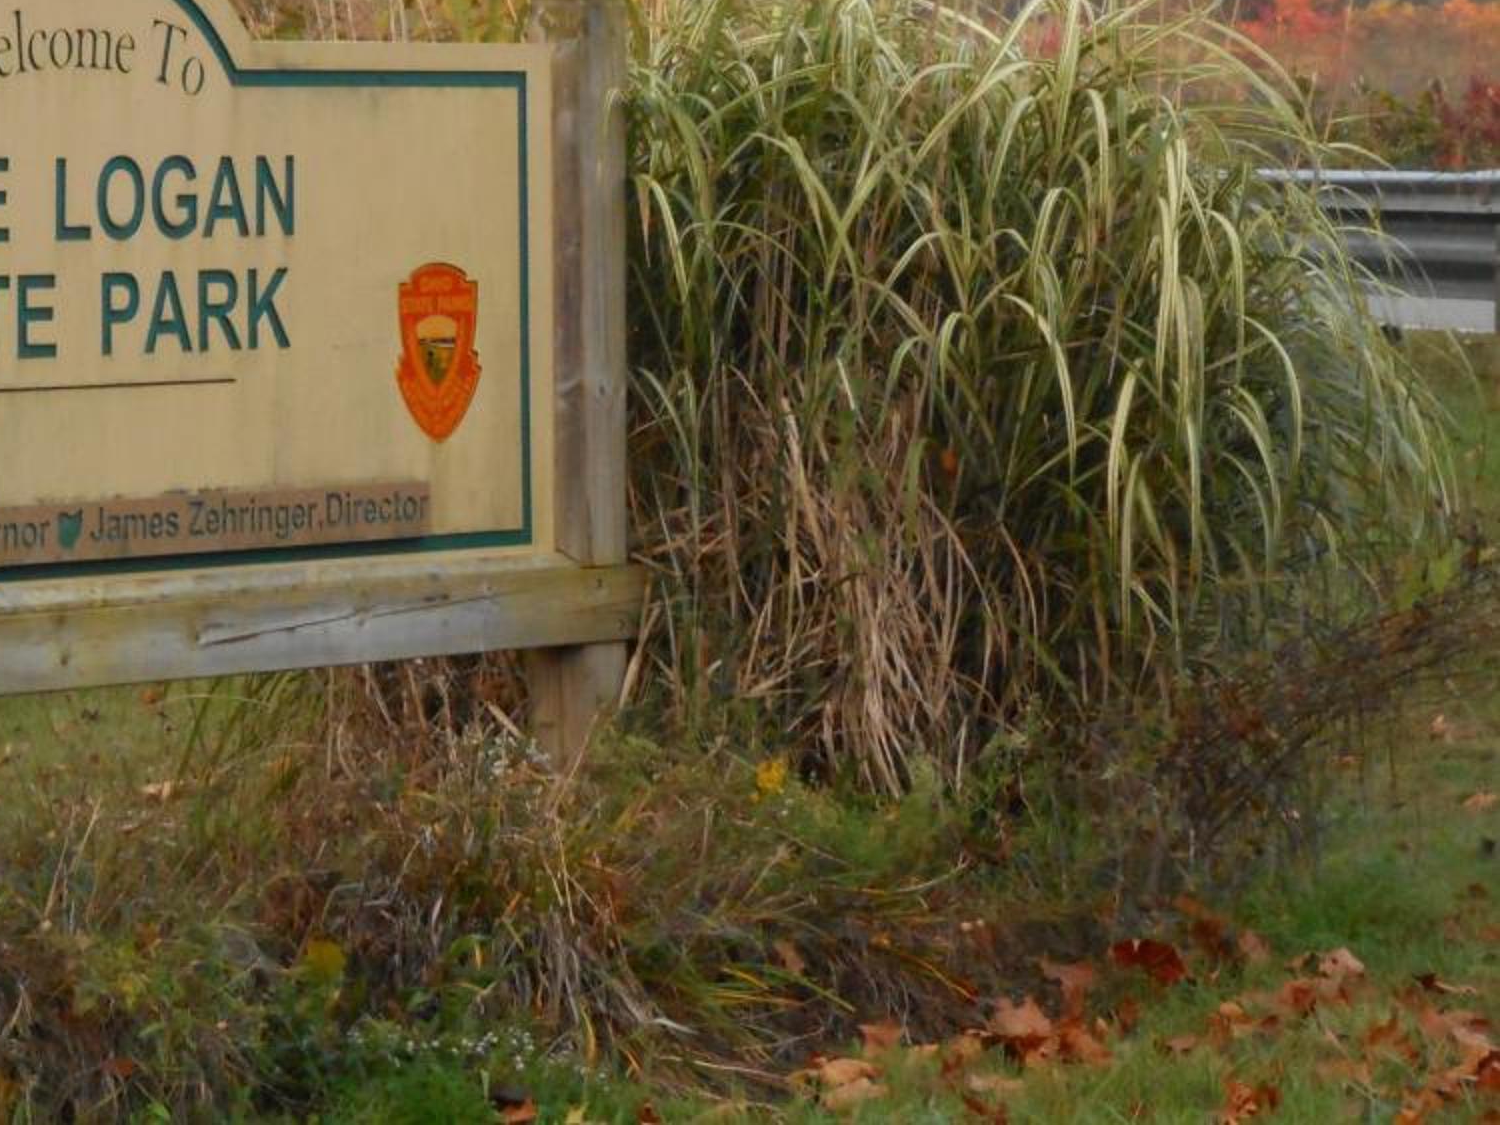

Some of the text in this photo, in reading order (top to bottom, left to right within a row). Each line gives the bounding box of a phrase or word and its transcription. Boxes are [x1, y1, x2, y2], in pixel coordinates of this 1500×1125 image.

[152, 18, 205, 96] To
[54, 154, 296, 241] LOGAN
[100, 266, 292, 356] PARK
[89, 507, 180, 542] James
